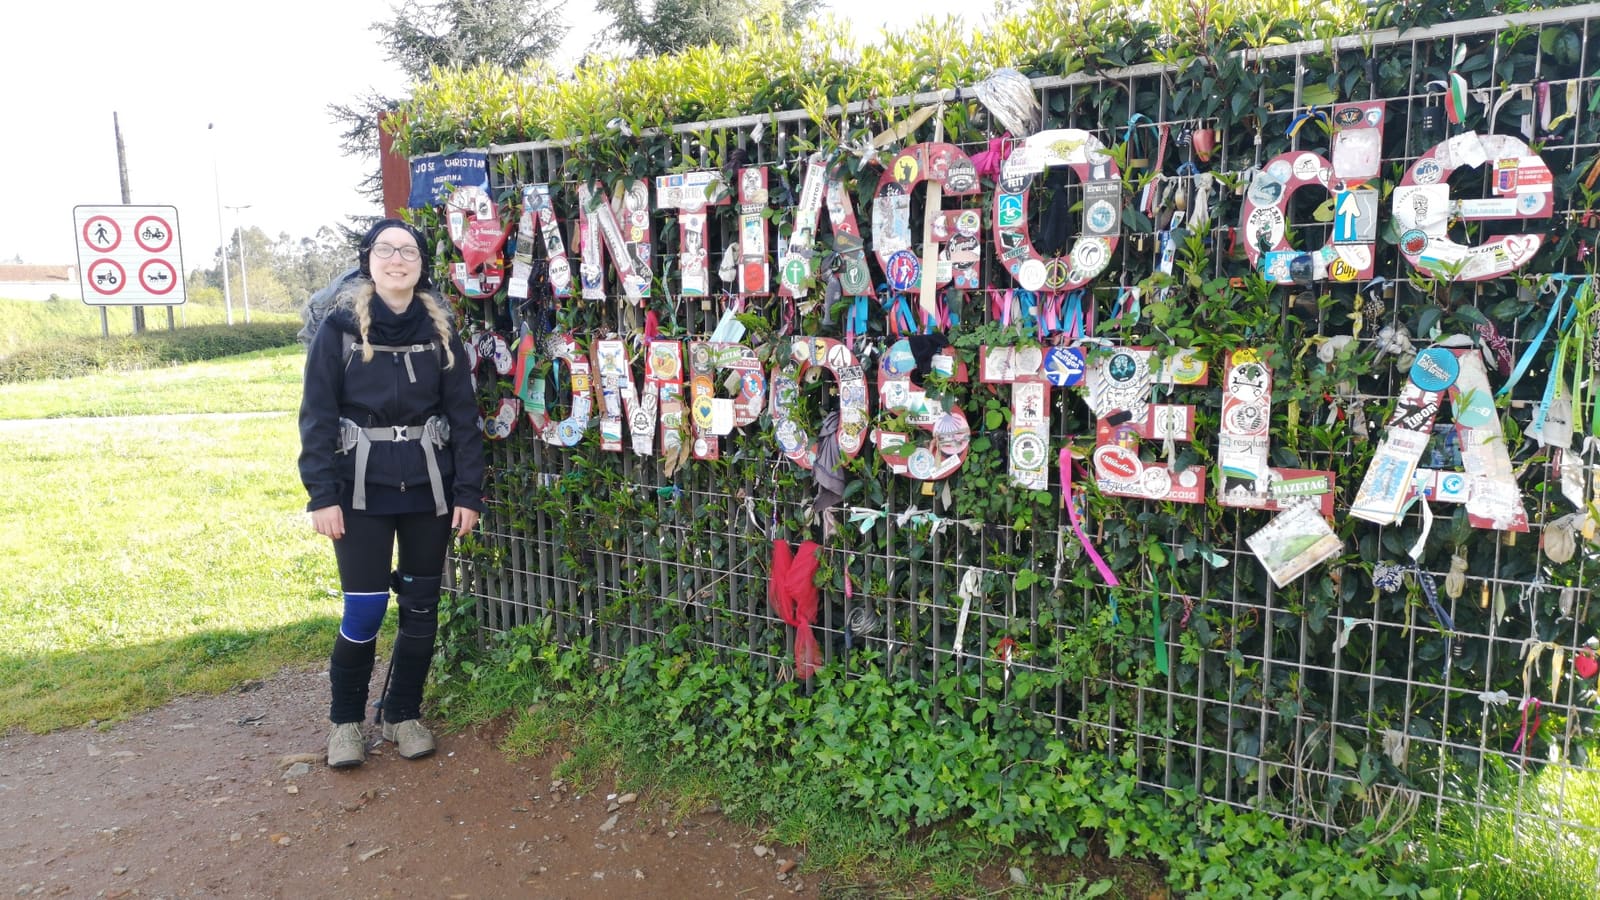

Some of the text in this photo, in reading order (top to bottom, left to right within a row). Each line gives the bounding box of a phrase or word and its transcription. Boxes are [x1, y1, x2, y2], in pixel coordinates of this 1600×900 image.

[415, 158, 485, 173] JOSE CHRISTIAN
[446, 128, 1122, 301] SANTIAGO
[468, 331, 1529, 533] COMPOSTELA
